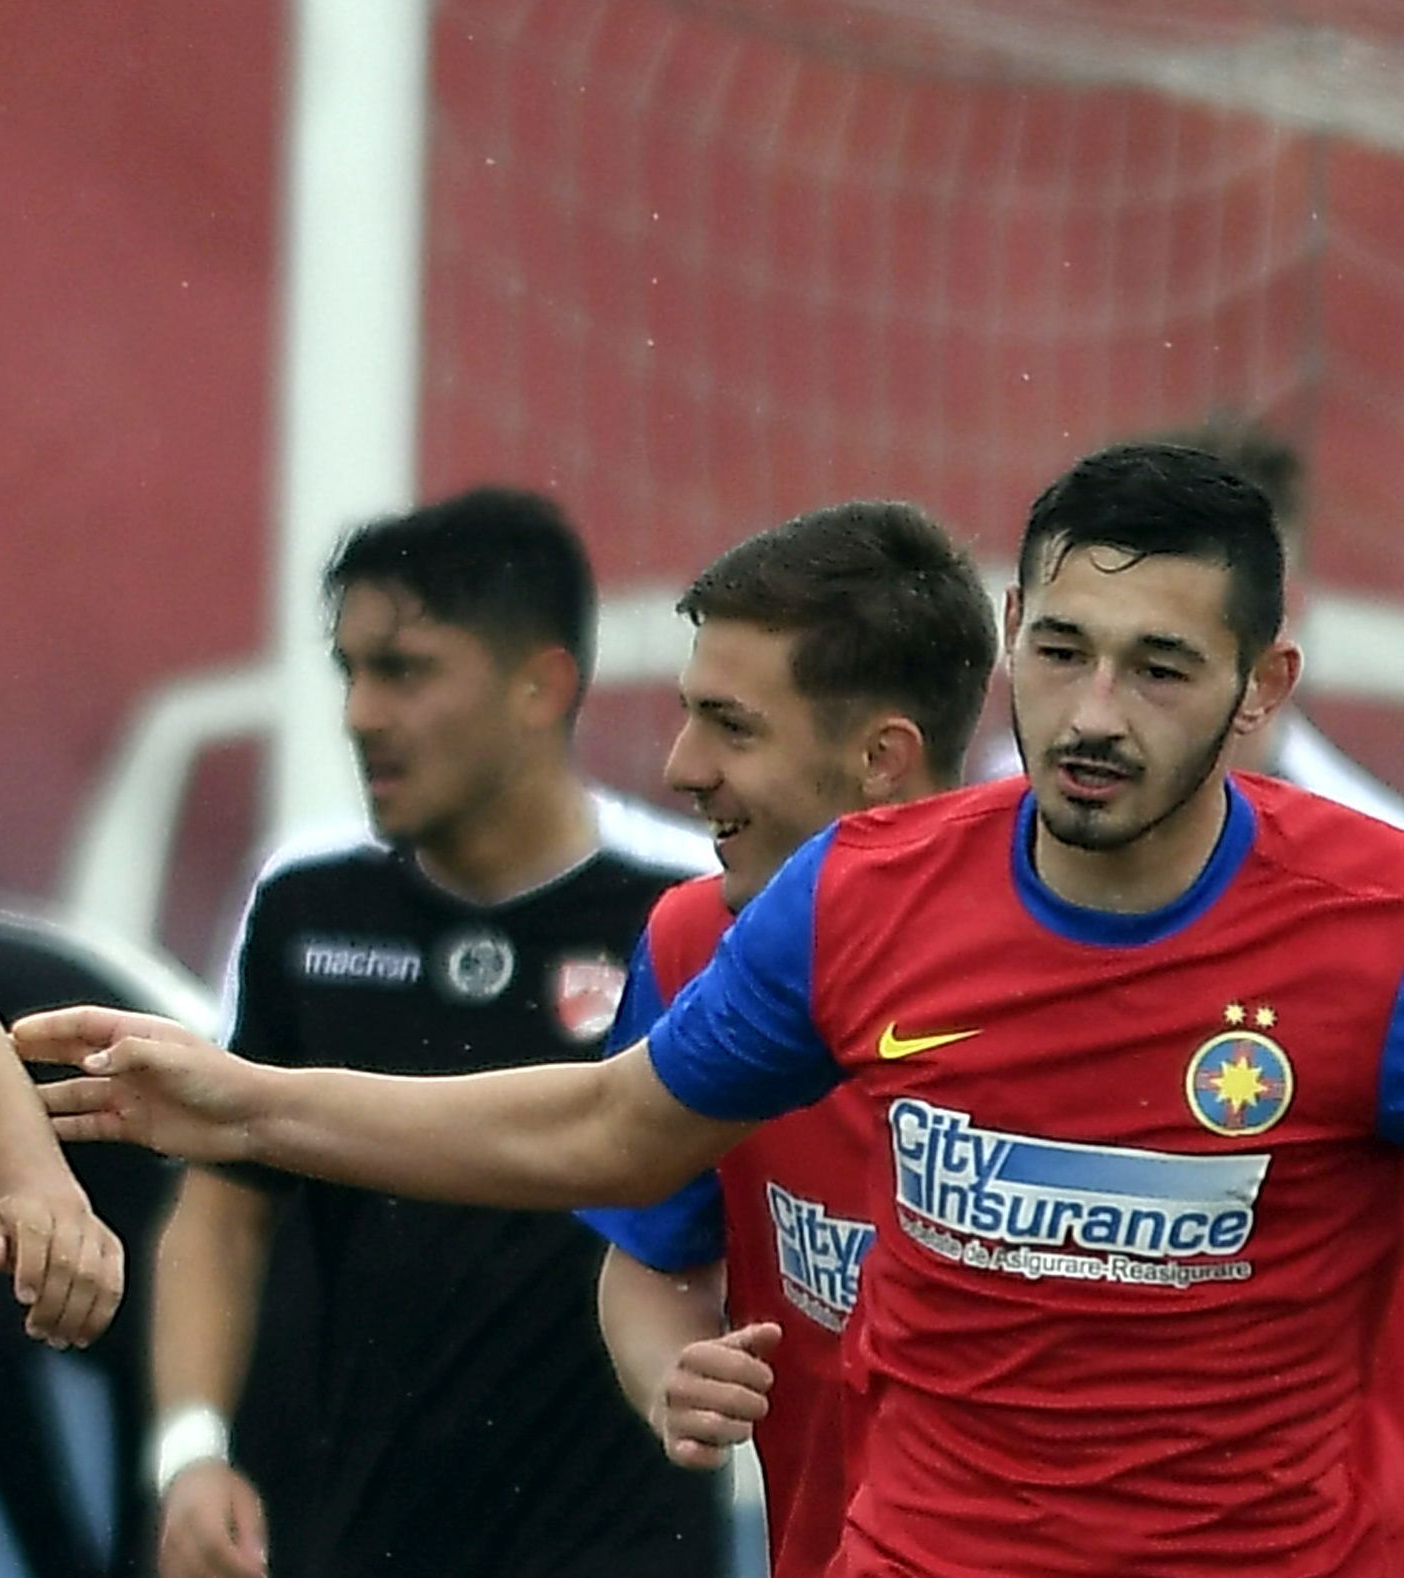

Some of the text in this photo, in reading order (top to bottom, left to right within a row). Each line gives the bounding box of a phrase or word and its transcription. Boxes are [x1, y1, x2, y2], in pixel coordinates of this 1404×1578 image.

[304, 947, 422, 984] macron
[894, 1102, 1010, 1197] City
[770, 1187, 859, 1275] City
[925, 1178, 1249, 1250] Insurance
[996, 1247, 1250, 1286] Asigurare-Reasigurare
